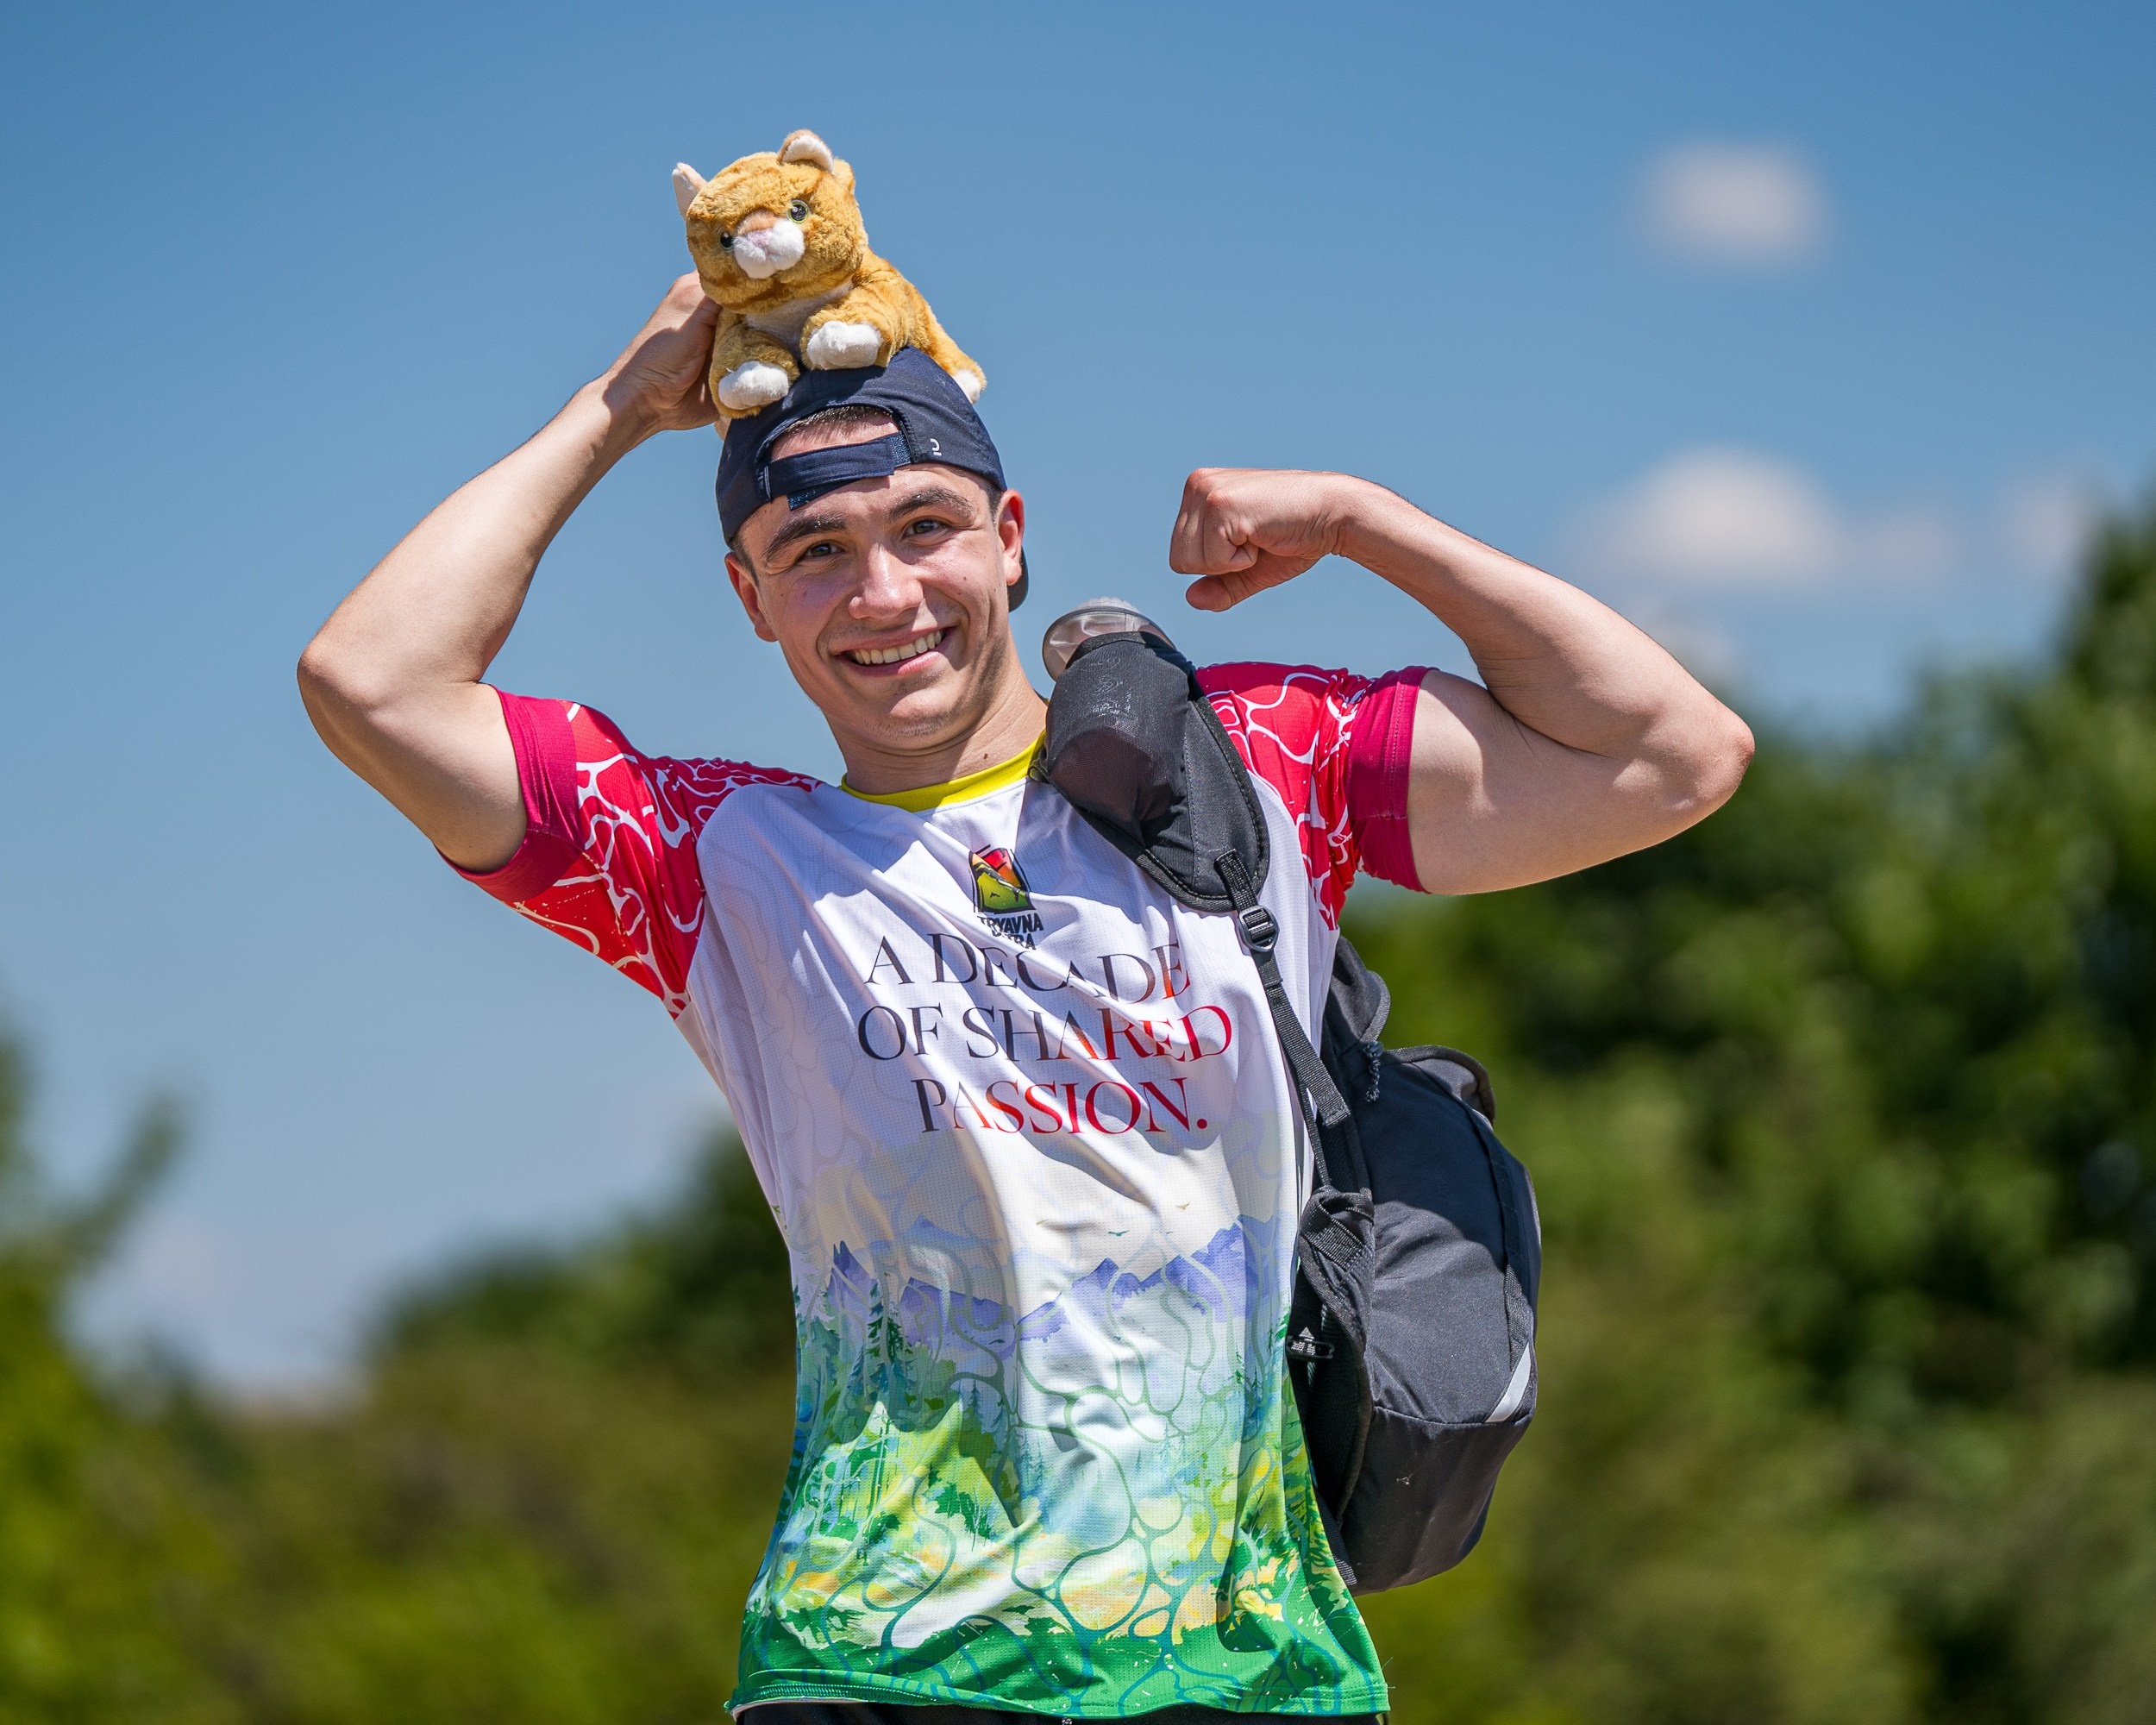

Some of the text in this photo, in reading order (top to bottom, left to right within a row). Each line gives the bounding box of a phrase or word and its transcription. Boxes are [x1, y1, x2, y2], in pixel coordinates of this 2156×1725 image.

[863, 936, 915, 985] A
[858, 1002, 1232, 1063] OF SHARED
[911, 1077, 1208, 1135] PASSION.
